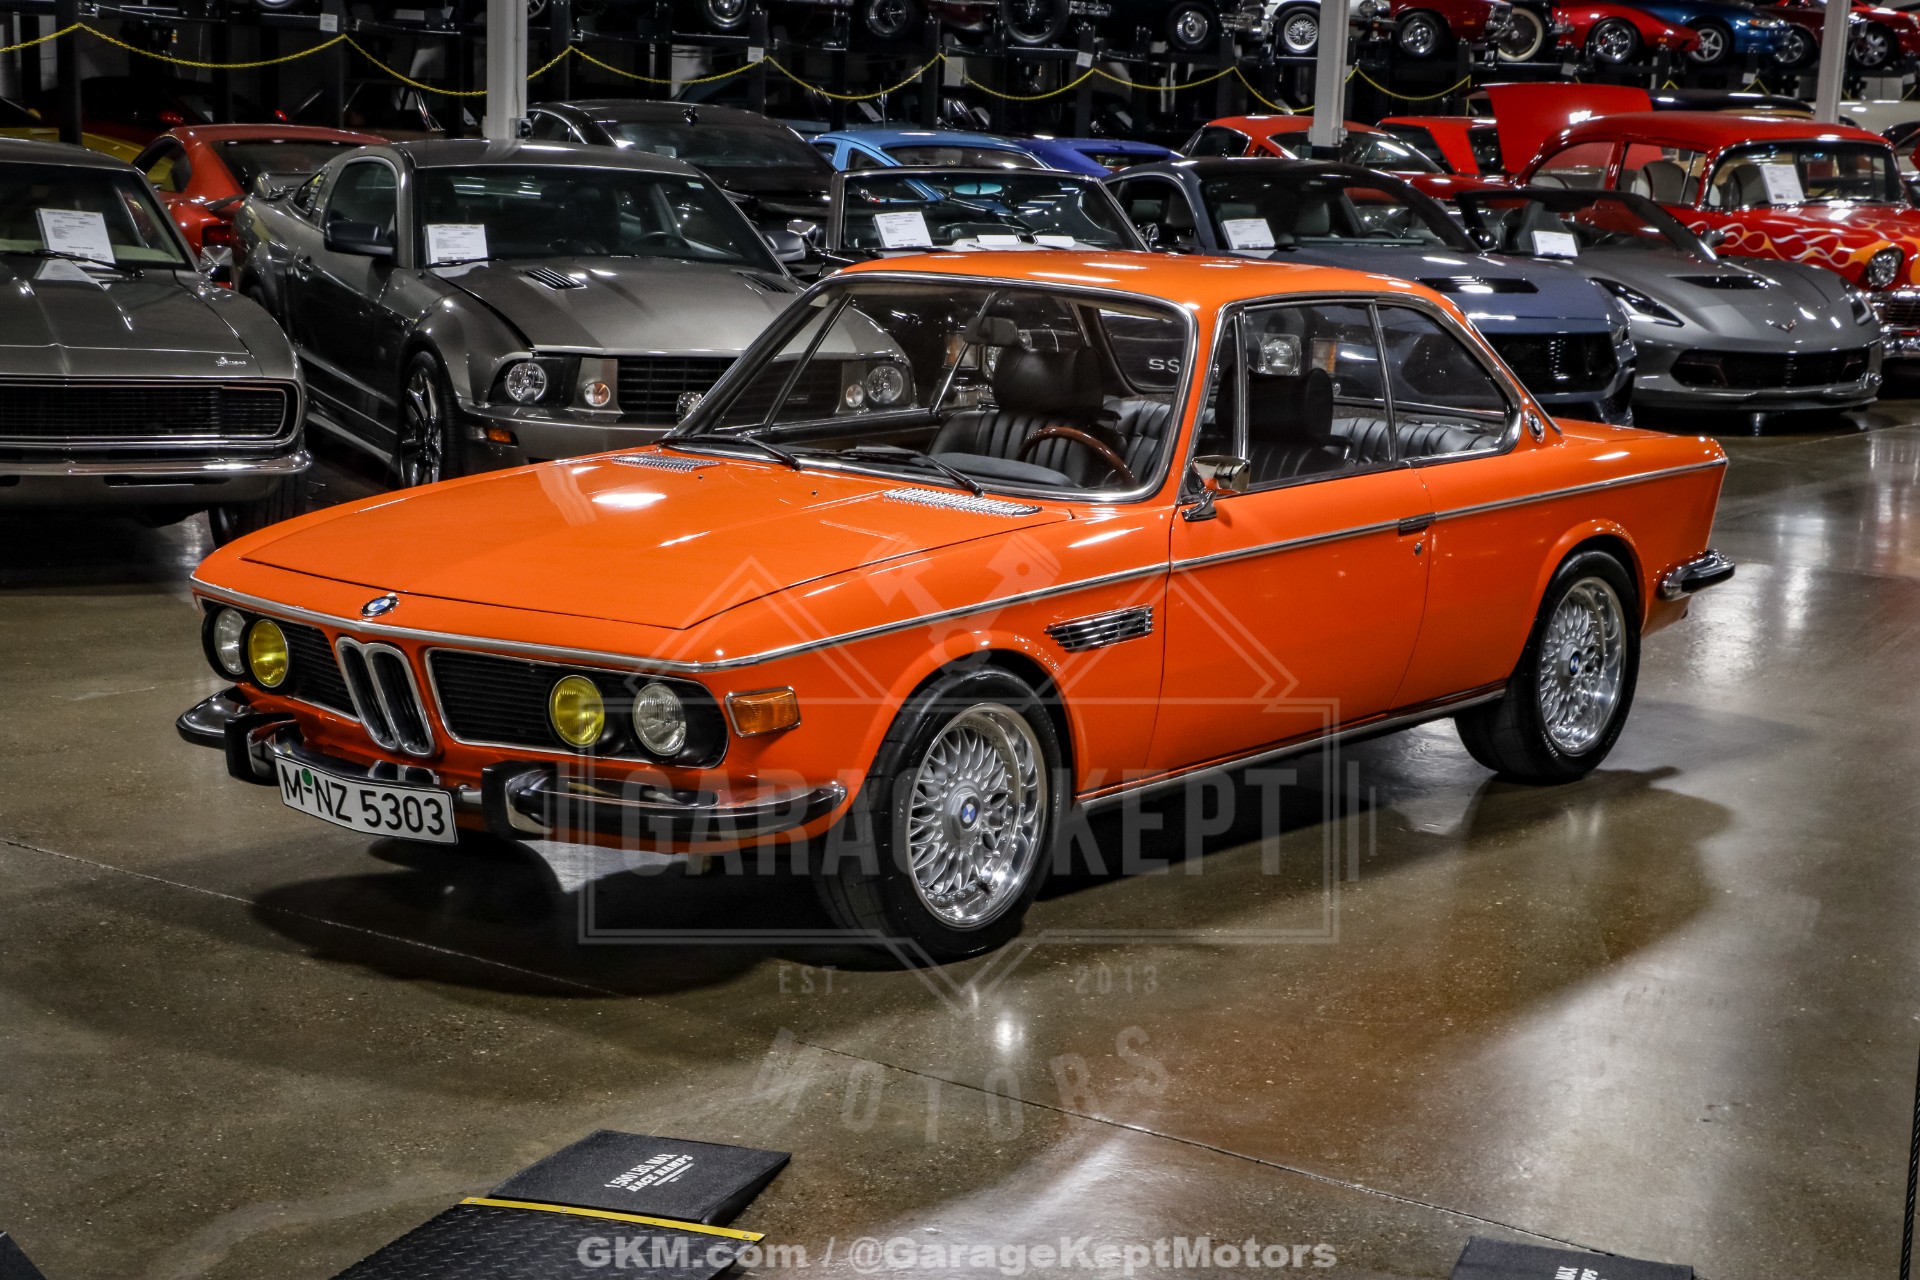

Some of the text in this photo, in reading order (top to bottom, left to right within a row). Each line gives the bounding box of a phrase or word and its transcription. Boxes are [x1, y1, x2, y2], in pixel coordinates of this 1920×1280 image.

[1149, 358, 1180, 373] SS
[360, 789, 445, 836] 5303
[625, 1173, 659, 1192] RACE
[653, 1154, 694, 1176] RAMPS
